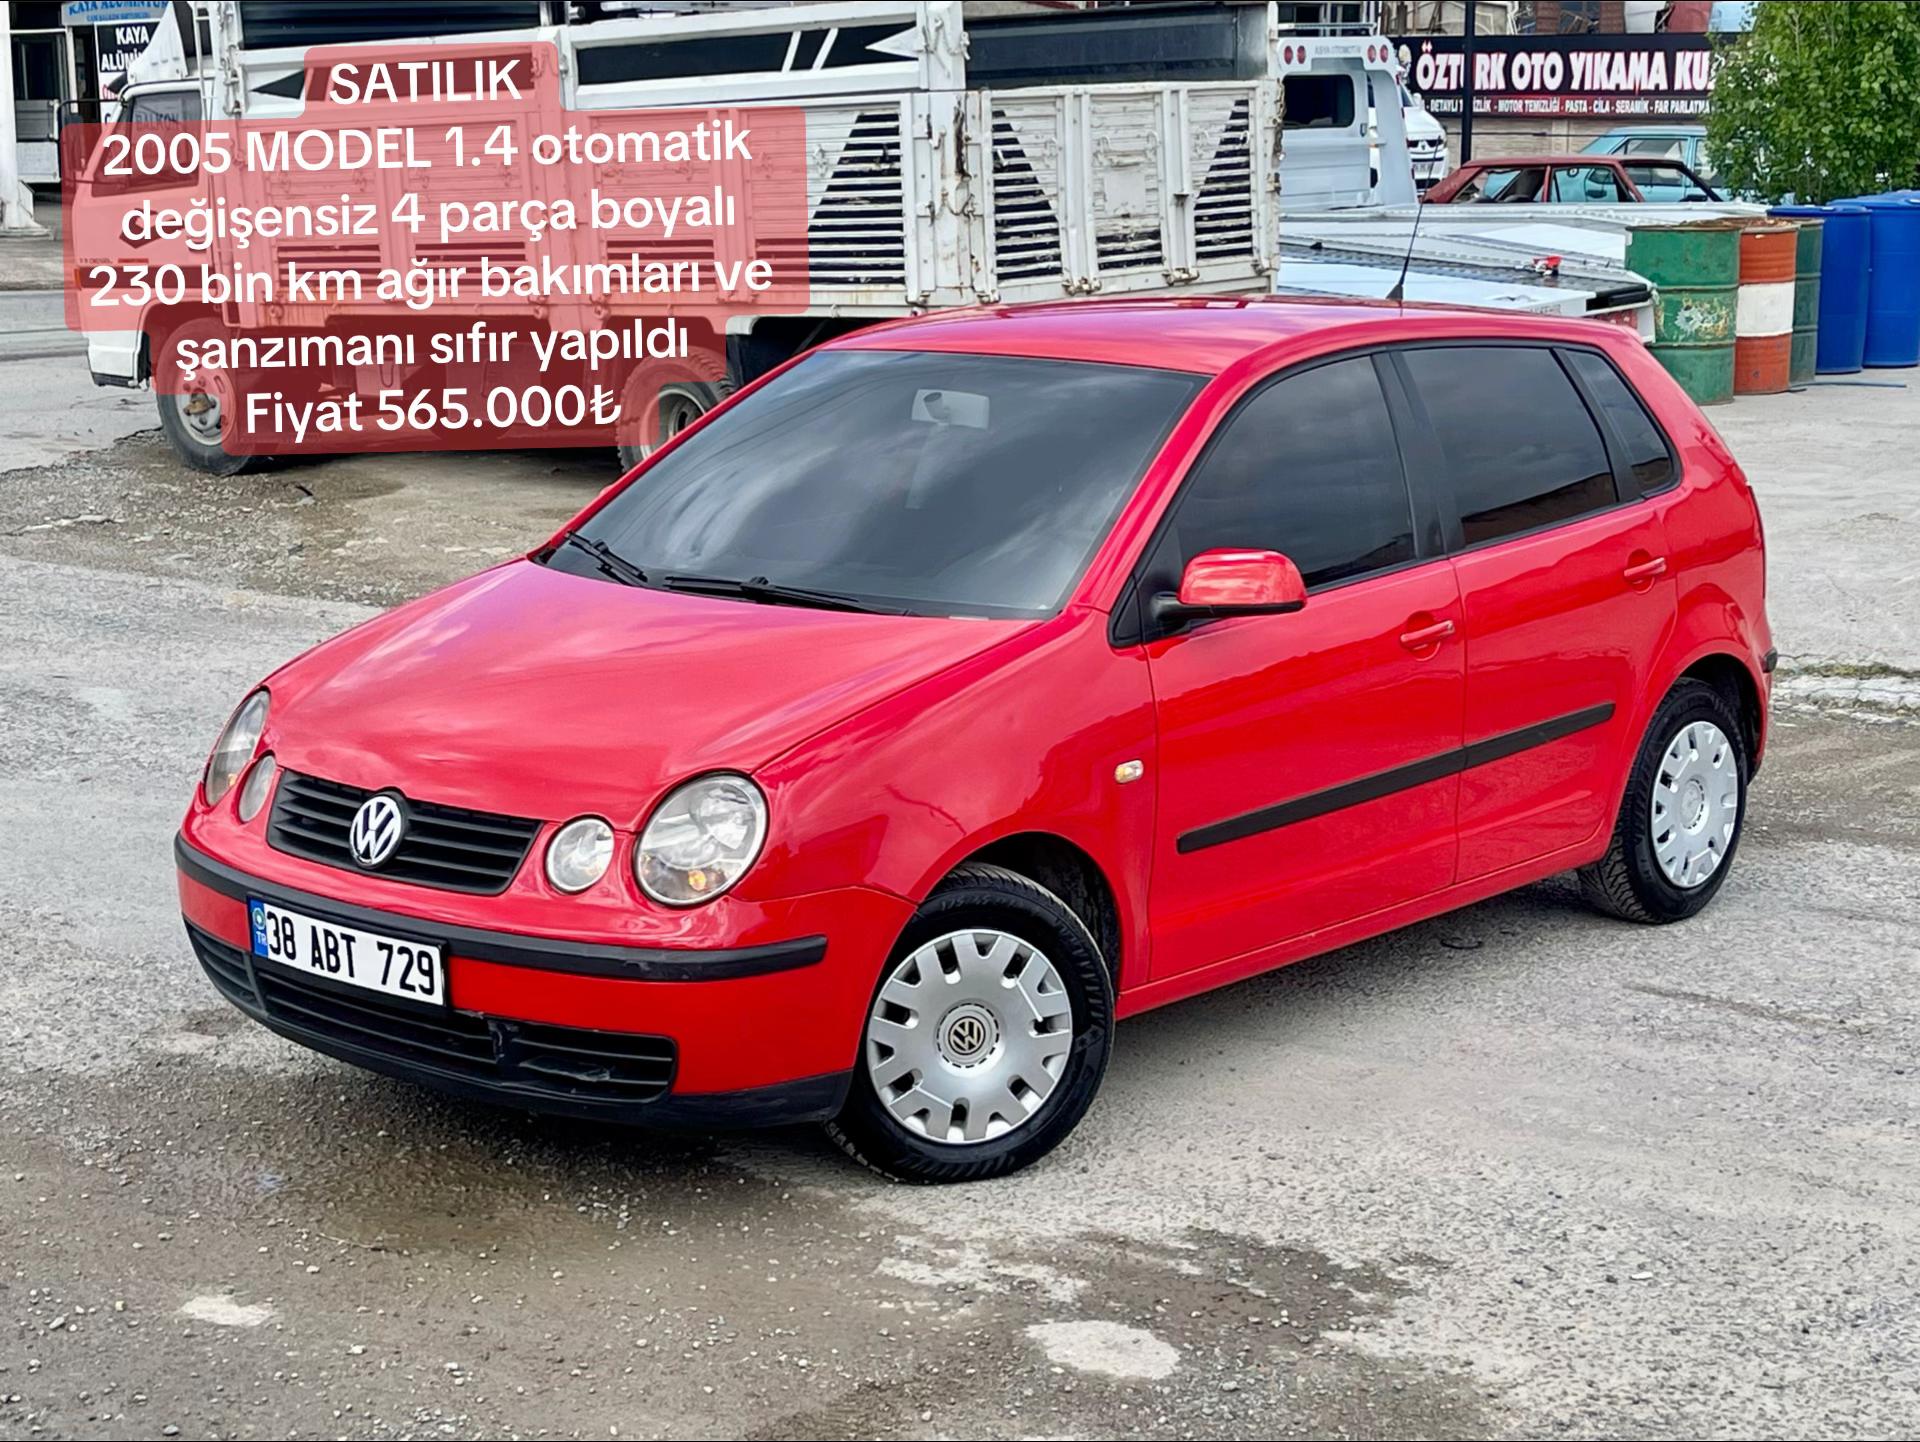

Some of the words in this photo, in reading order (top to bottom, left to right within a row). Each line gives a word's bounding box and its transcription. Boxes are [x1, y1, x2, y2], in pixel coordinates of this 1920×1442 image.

[115, 26, 149, 45] KAYA
[1416, 40, 1507, 91] ÖZTRK
[1511, 51, 1564, 91] OTO
[1569, 51, 1669, 91] YIKAMA
[1498, 99, 1523, 113] MOTOR
[1565, 99, 1588, 113] PASTA
[1593, 97, 1610, 113] CİLA
[1615, 97, 1649, 114] SERAMİK
[1654, 99, 1669, 114] FAR
[256, 930, 268, 946] TR
[267, 911, 297, 961] 38
[311, 925, 356, 979] ABT
[377, 941, 435, 996] 729
